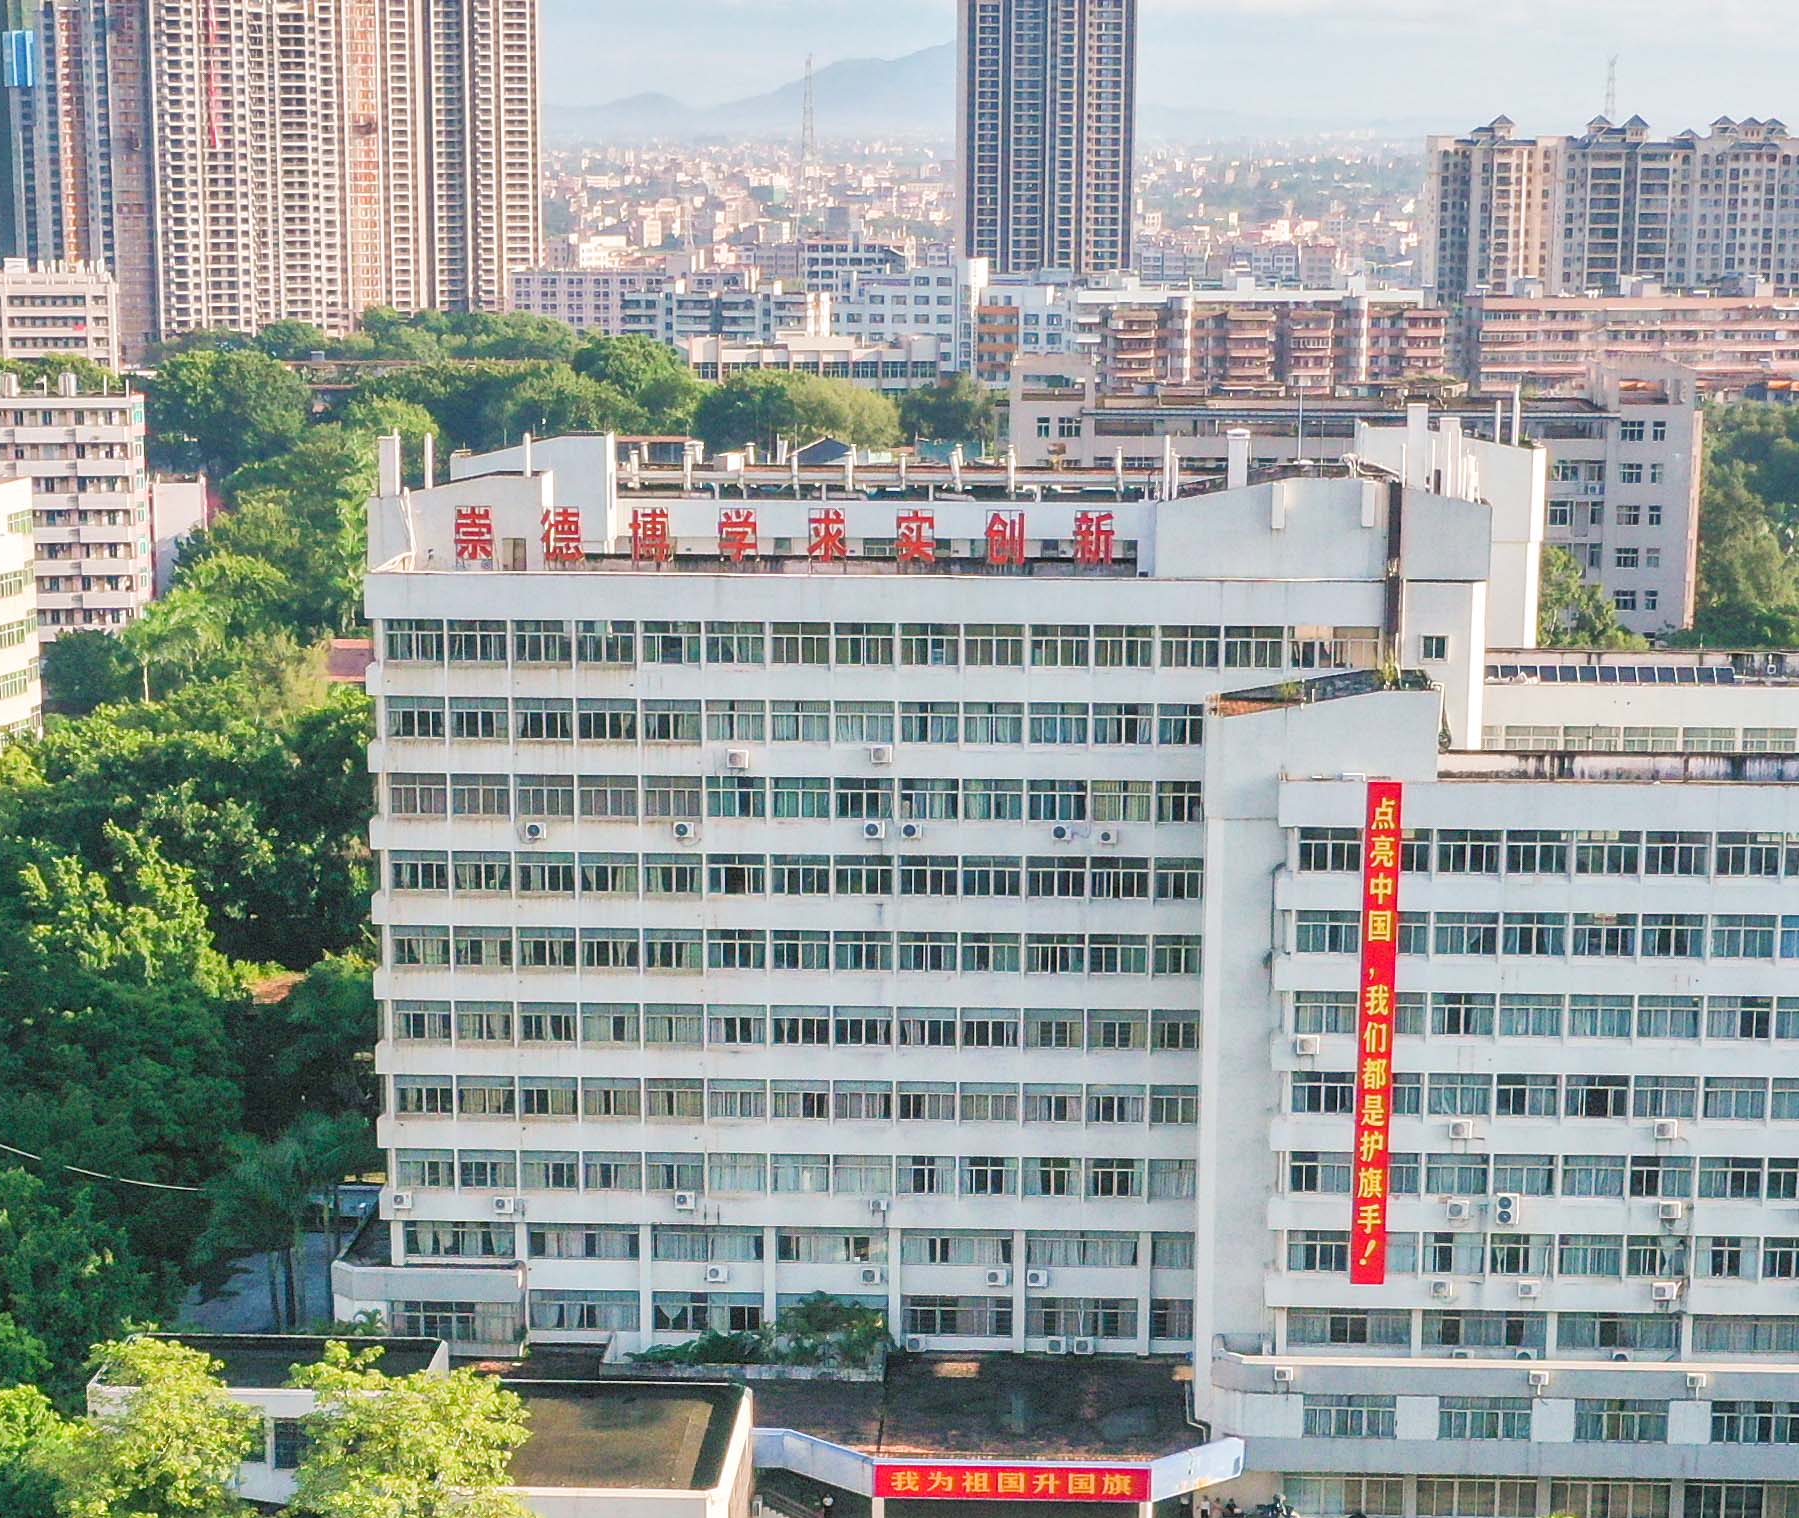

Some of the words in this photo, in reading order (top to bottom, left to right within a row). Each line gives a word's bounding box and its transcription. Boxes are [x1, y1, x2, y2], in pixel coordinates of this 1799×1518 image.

[454, 505, 1115, 564] 崇德博学求实创新
[890, 1471, 1133, 1496] 我为祖国升国旗
